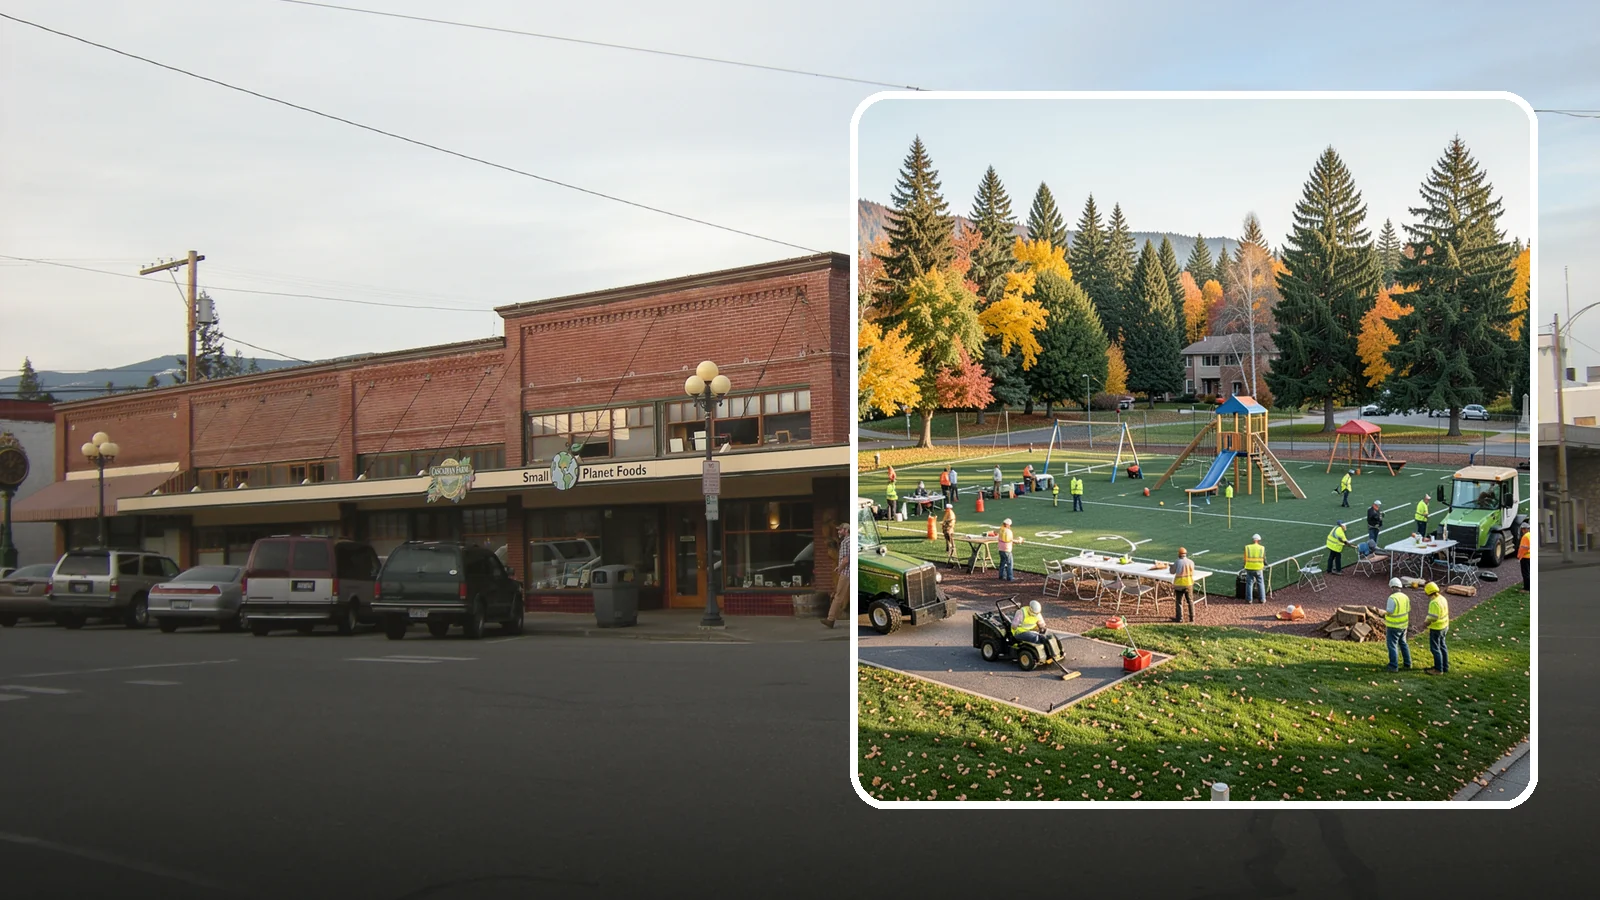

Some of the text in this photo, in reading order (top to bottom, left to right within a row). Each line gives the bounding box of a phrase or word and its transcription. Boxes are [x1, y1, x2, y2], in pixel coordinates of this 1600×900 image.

[523, 464, 647, 483] Small Planet Foods
